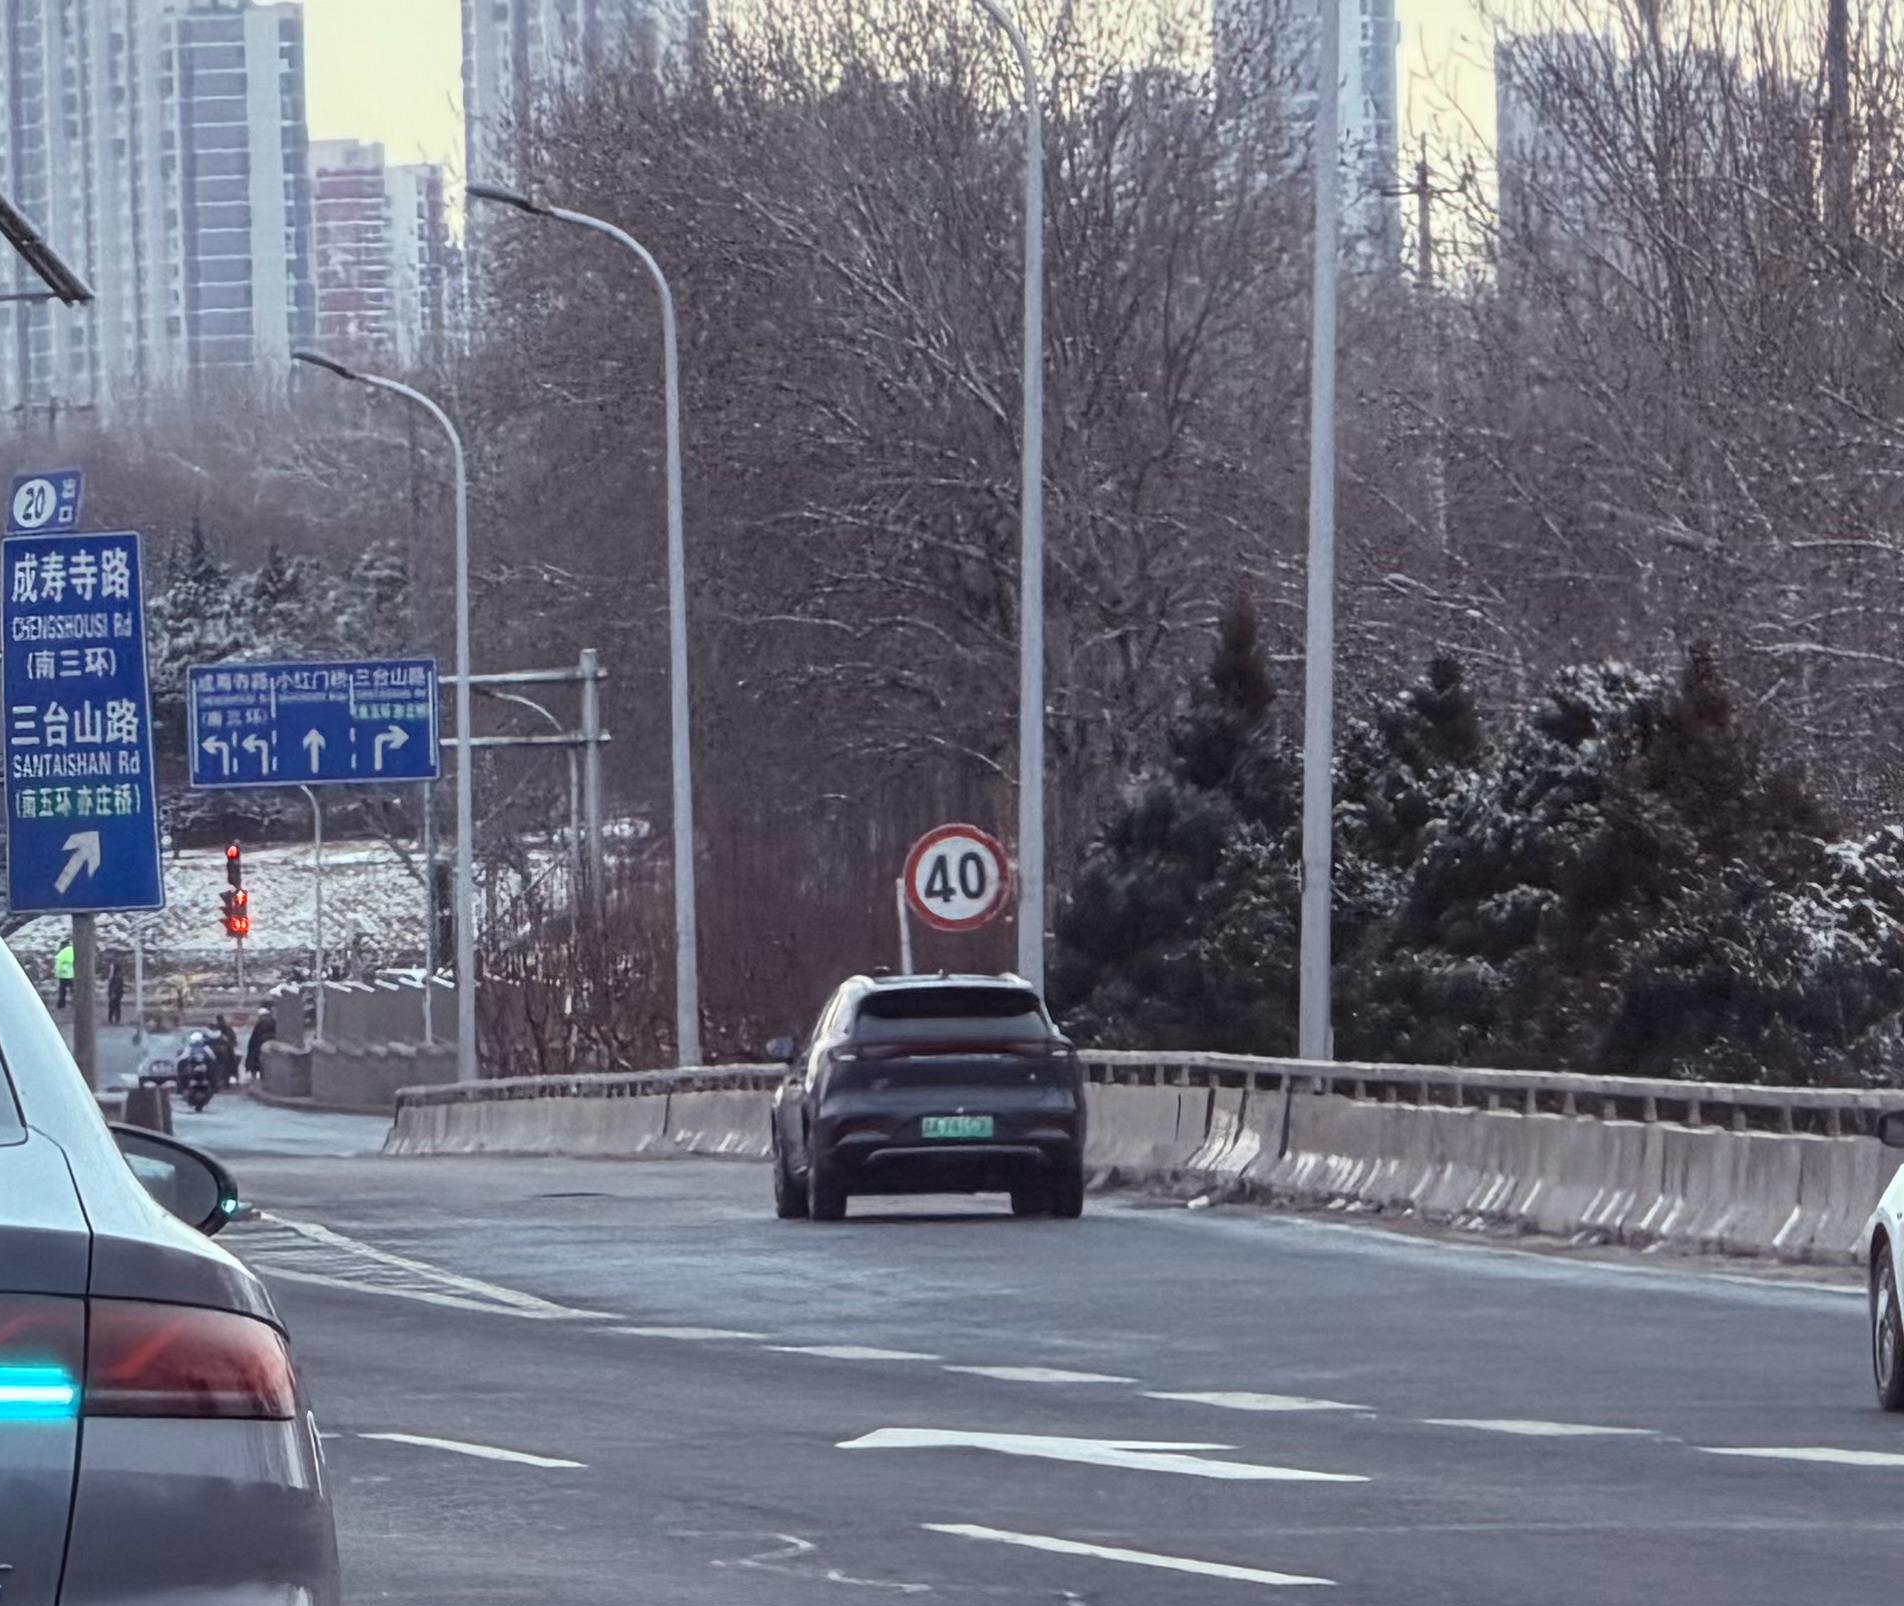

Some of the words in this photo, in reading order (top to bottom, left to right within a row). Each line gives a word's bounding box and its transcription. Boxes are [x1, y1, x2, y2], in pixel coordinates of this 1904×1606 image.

[22, 486, 45, 521] 20
[11, 547, 131, 603] 成寿寺路
[113, 611, 132, 638] Rd
[26, 648, 118, 680] (南三环)
[10, 697, 139, 748] 三台山路
[12, 752, 112, 779] SANTAISHAN
[118, 750, 141, 775] Rd
[924, 851, 986, 903] 40
